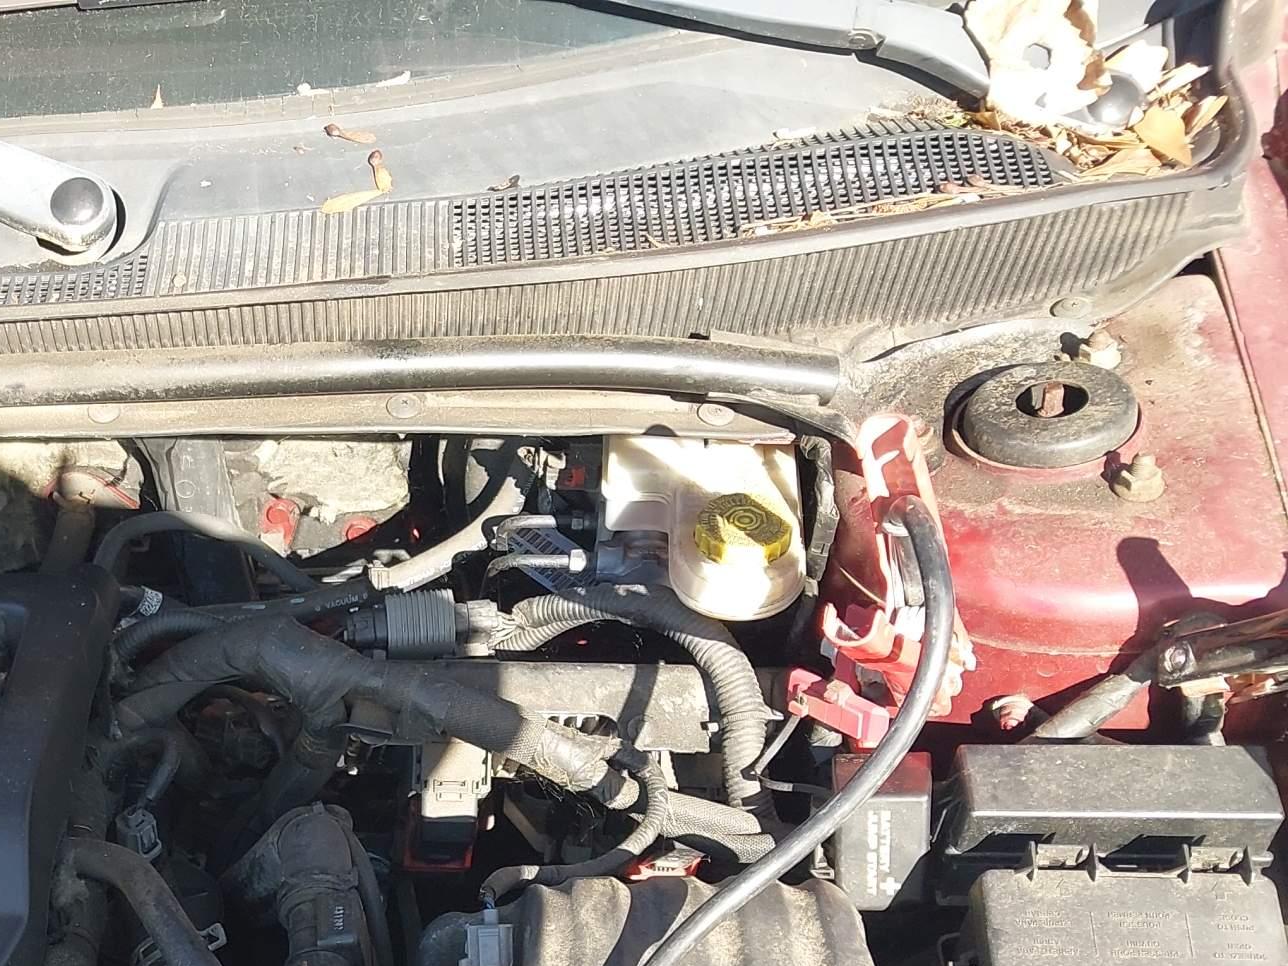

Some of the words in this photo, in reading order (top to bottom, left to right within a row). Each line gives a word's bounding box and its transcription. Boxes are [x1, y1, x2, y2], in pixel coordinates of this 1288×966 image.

[866, 809, 879, 850] JUMP
[879, 809, 892, 873] BATTERY
[866, 852, 879, 897] START
